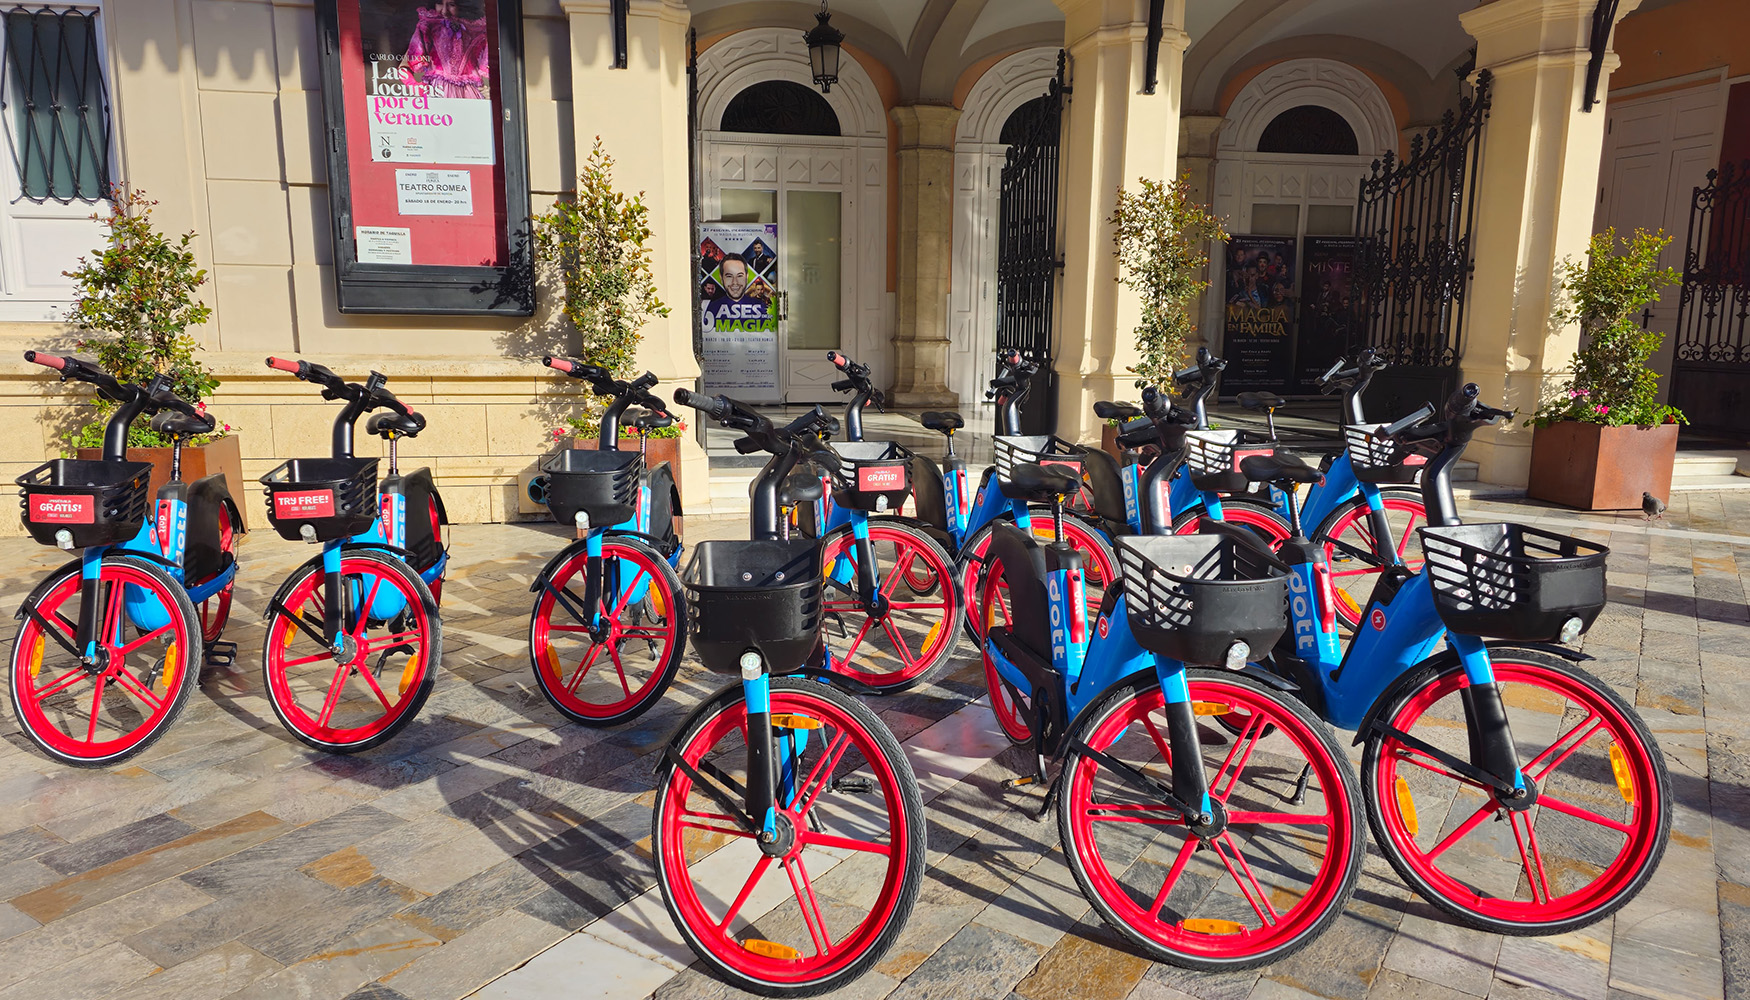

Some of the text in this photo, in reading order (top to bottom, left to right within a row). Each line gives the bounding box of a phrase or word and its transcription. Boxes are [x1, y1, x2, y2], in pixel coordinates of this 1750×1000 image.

[369, 53, 395, 61] CARLO
[370, 61, 409, 80] Las
[372, 78, 445, 98] locuras
[374, 93, 430, 113] por el
[374, 112, 453, 126] veraneo
[436, 184, 467, 192] ROMEA
[1309, 257, 1351, 273] MISTE
[701, 300, 762, 333] 6 ASES
[1229, 307, 1289, 323] MAGIA
[715, 319, 775, 333] MAGIA
[1227, 321, 1289, 337] EN FAMILIA
[868, 473, 897, 482] GRATIS!
[278, 495, 329, 506] TRY FREE!
[944, 476, 957, 528] dott
[1122, 470, 1138, 520] dott
[40, 502, 82, 512] GRATIS!
[159, 514, 167, 533] dott
[1074, 591, 1084, 615] dott
[1290, 571, 1315, 650] dott
[1048, 579, 1065, 661] dott
